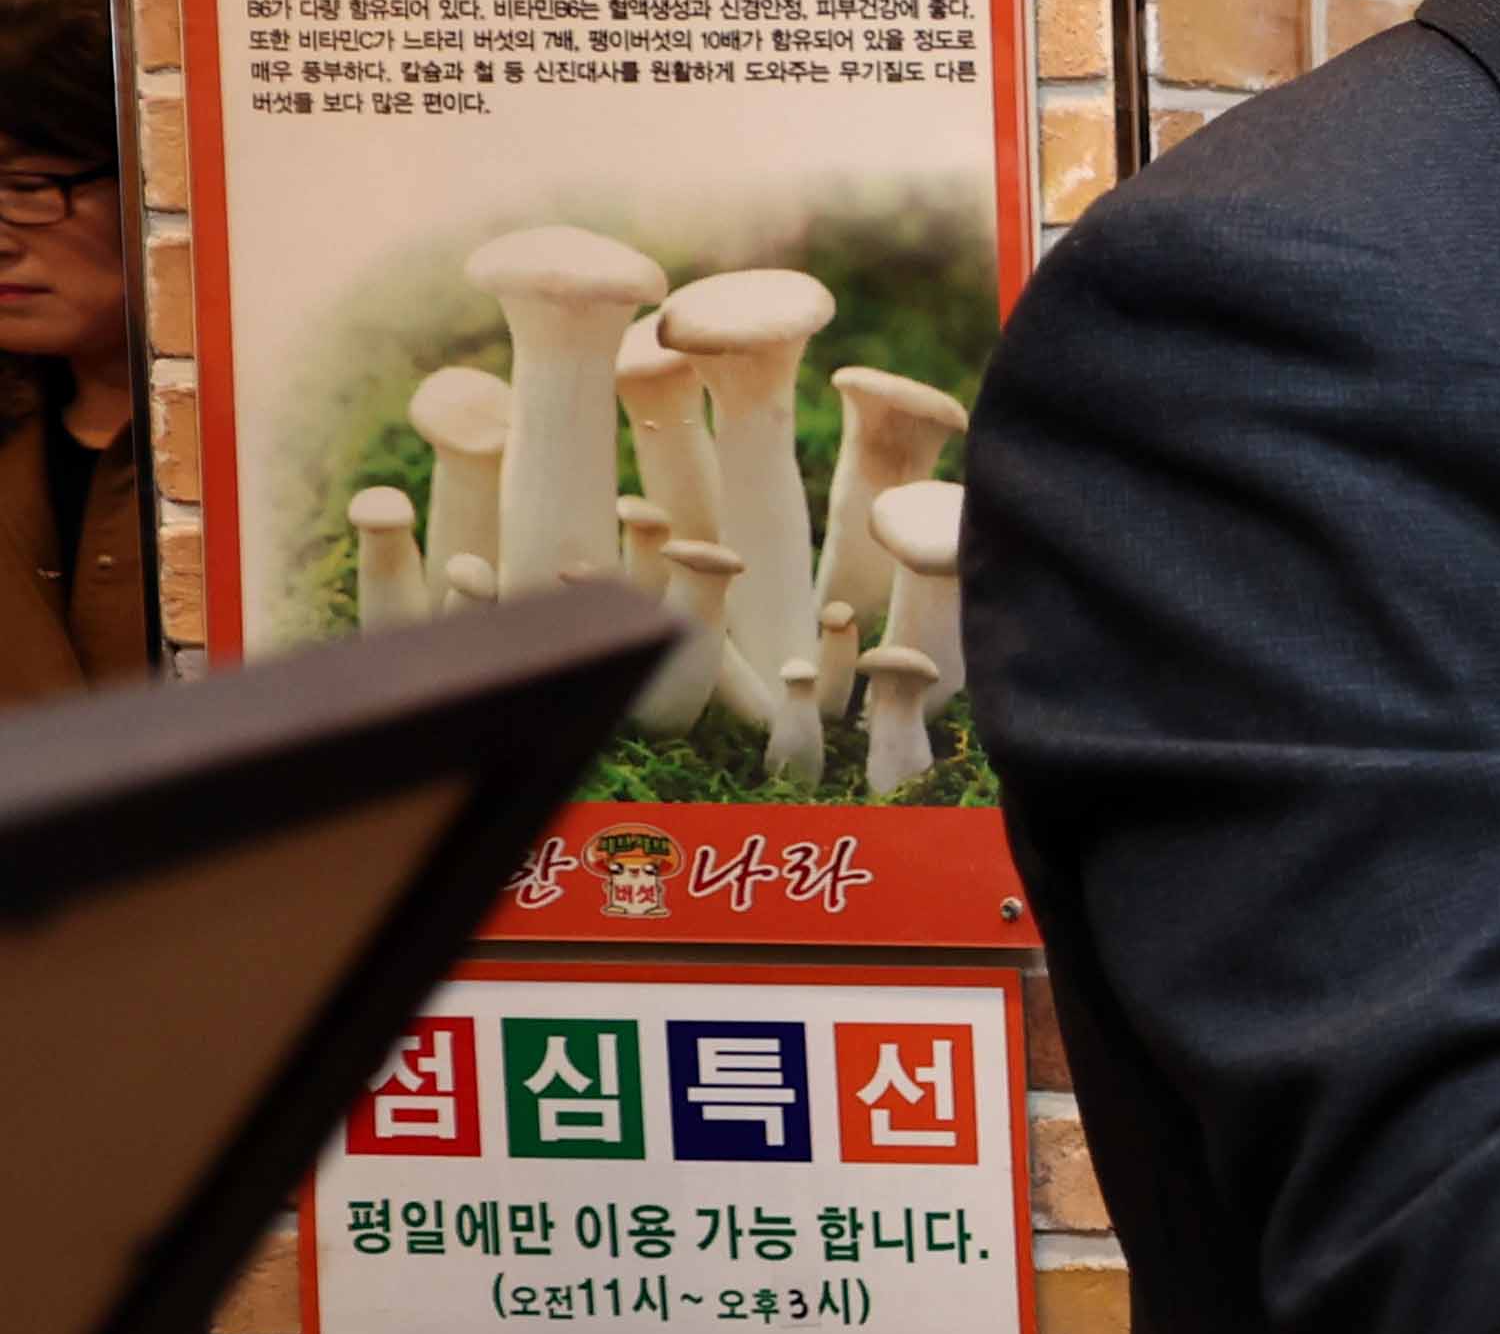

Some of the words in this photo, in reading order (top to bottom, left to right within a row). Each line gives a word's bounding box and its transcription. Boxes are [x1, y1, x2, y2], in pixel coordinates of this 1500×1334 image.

[248, 28, 292, 52] 또한
[298, 28, 396, 52] 비타민C가
[402, 28, 465, 53] 느타리
[473, 28, 536, 53] 버섯의
[587, 28, 694, 53] 팽이버섯의
[699, 28, 764, 52] 10배가
[912, 26, 977, 52] 정도로
[250, 60, 293, 83] 매우
[744, 59, 832, 83] 도와주는
[838, 59, 926, 84] 무기질도
[934, 60, 979, 83] 다른
[322, 91, 365, 114] 보다
[371, 91, 415, 115] 많은
[688, 834, 874, 913] 나라
[613, 884, 658, 906] 버섯
[347, 1198, 554, 1257] 평일에만
[576, 1203, 676, 1260] 이용
[696, 1204, 798, 1261] 가능
[817, 1206, 991, 1264] 합니다.
